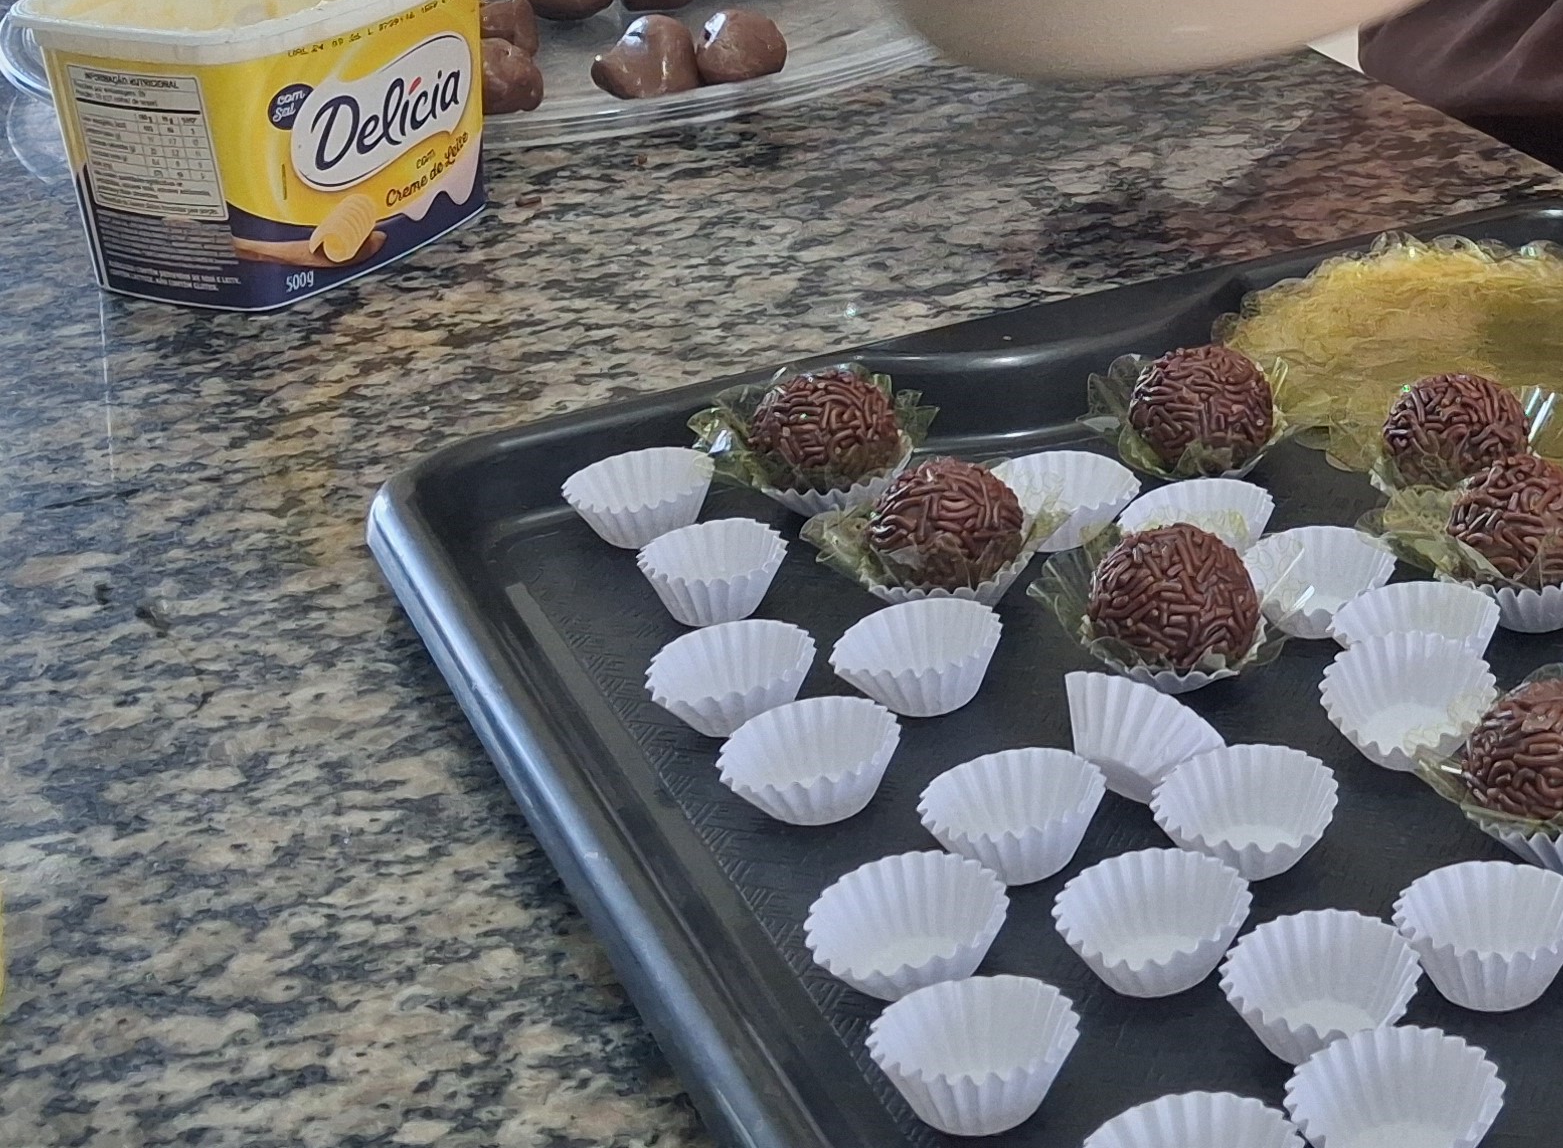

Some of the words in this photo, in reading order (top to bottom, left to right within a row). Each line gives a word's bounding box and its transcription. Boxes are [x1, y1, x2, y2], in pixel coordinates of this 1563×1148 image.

[277, 89, 306, 105] com
[310, 68, 461, 171] Delícia
[385, 173, 428, 208] Creme
[445, 131, 469, 168] Leite
[416, 148, 436, 169] com
[286, 270, 314, 293] 500g
